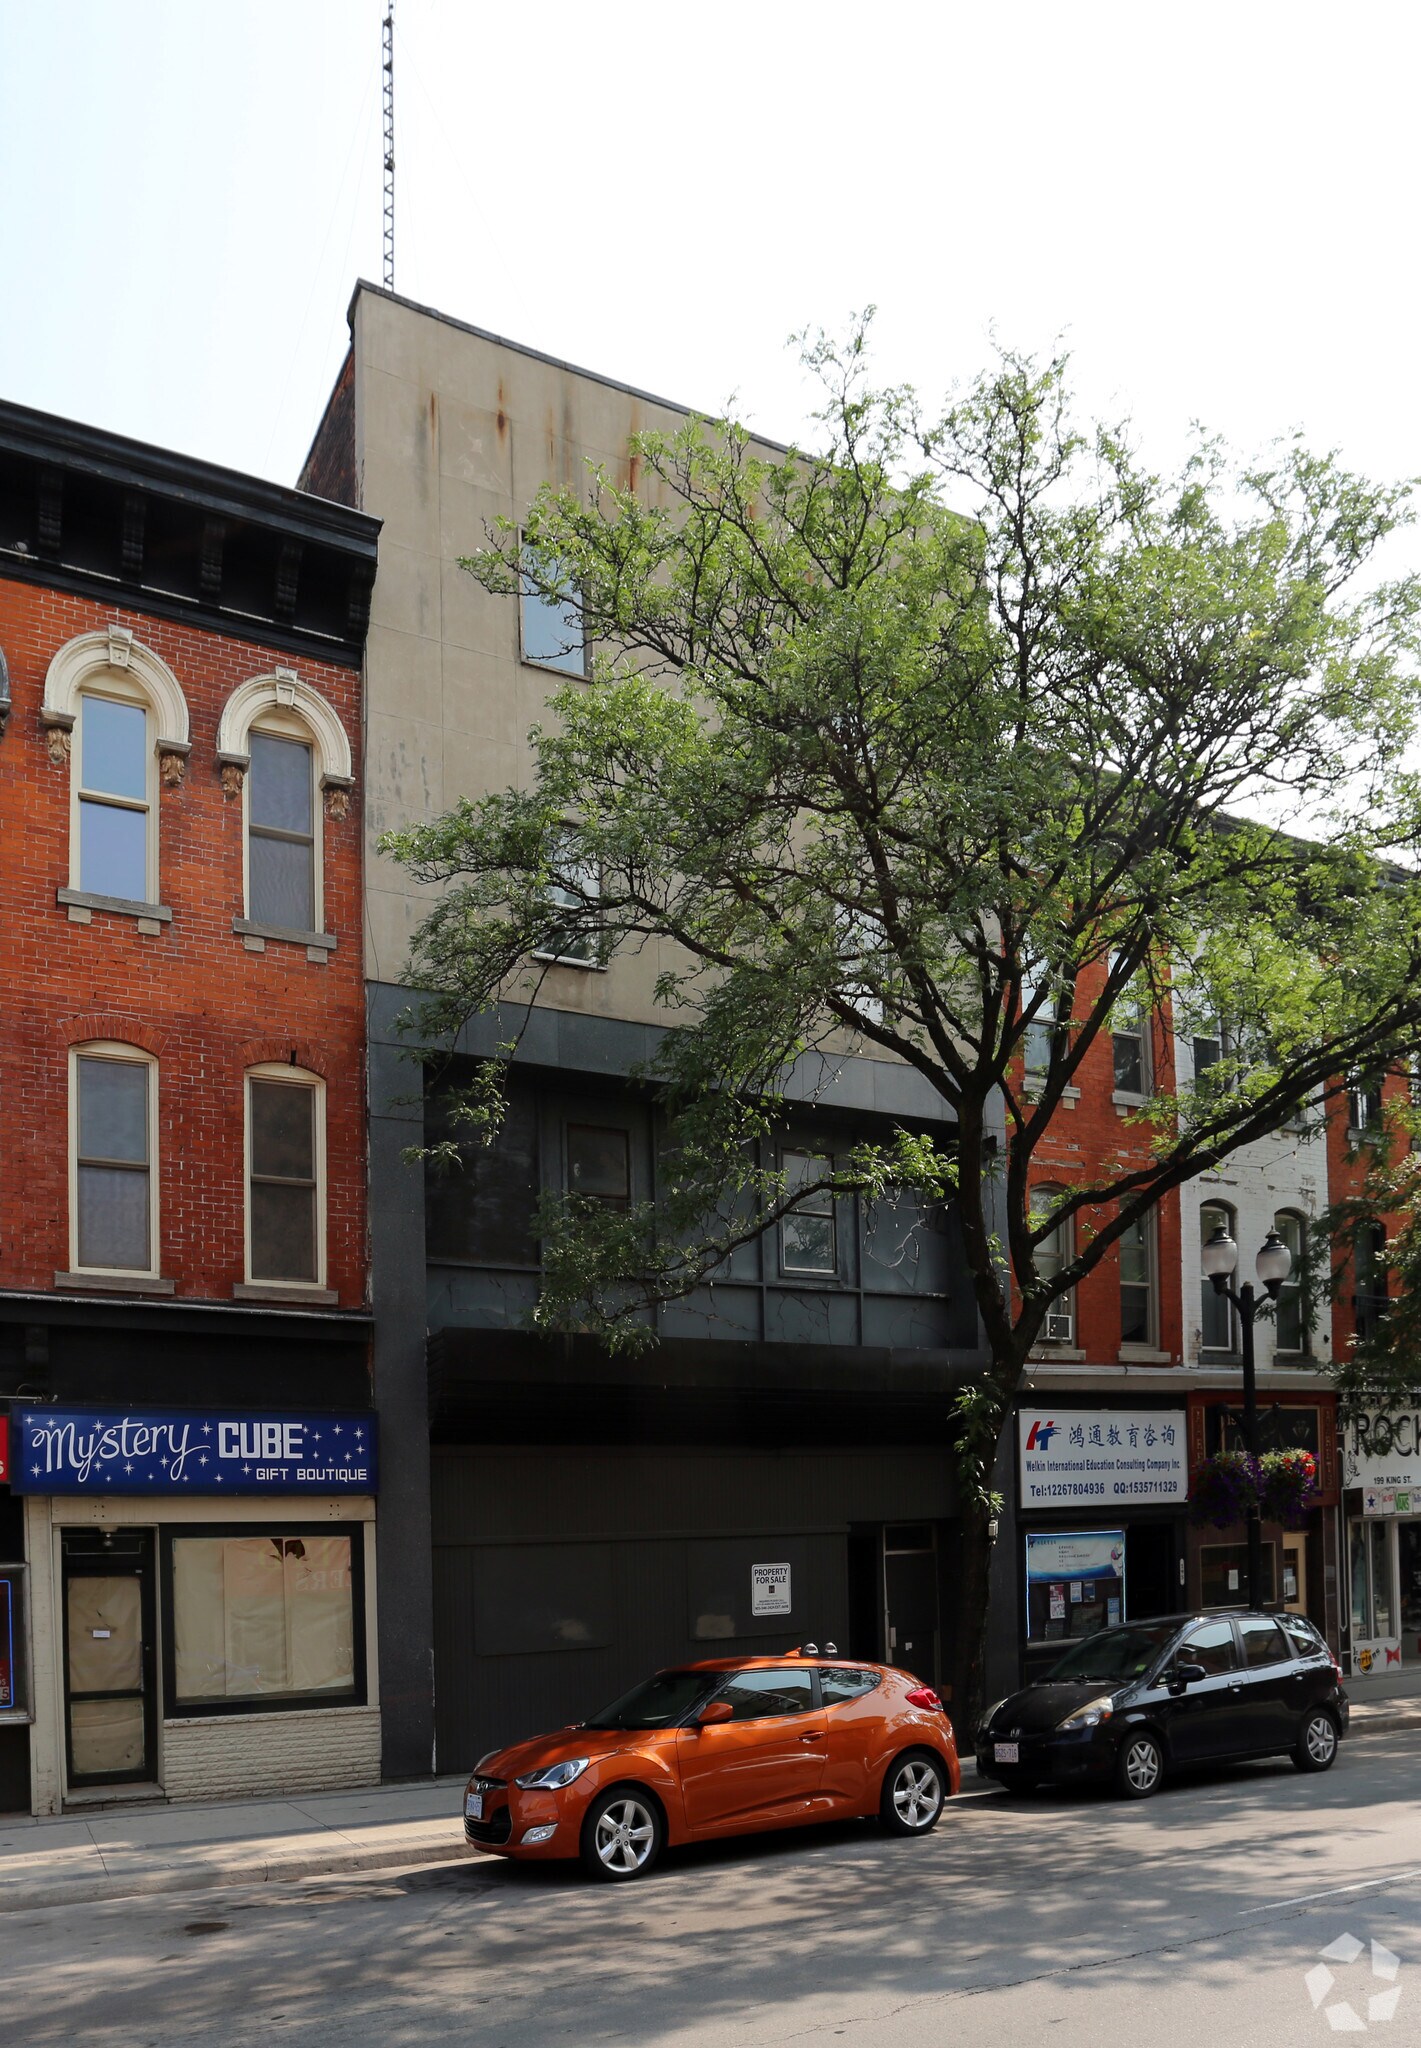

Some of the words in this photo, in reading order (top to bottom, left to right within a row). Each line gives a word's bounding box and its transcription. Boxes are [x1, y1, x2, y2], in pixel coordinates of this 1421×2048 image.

[1069, 1423, 1176, 1449] 鸿通教育咨询
[32, 1417, 210, 1483] Mystery
[218, 1422, 304, 1459] CUBE
[1026, 1460, 1046, 1472] Welkin
[1047, 1460, 1085, 1472] International
[1086, 1459, 1115, 1471] Education
[1116, 1458, 1146, 1472] Consulting
[1147, 1458, 1171, 1472] Company
[256, 1468, 289, 1481] GIFT
[297, 1468, 367, 1483] BOUTIQUE
[1373, 1476, 1384, 1485] 199
[1386, 1476, 1401, 1484] KING
[1030, 1482, 1105, 1497] Tel:12267804936
[1113, 1481, 1178, 1495] QQ:1535711329
[755, 1568, 787, 1576] PROPERTY
[771, 1576, 786, 1584] SALE
